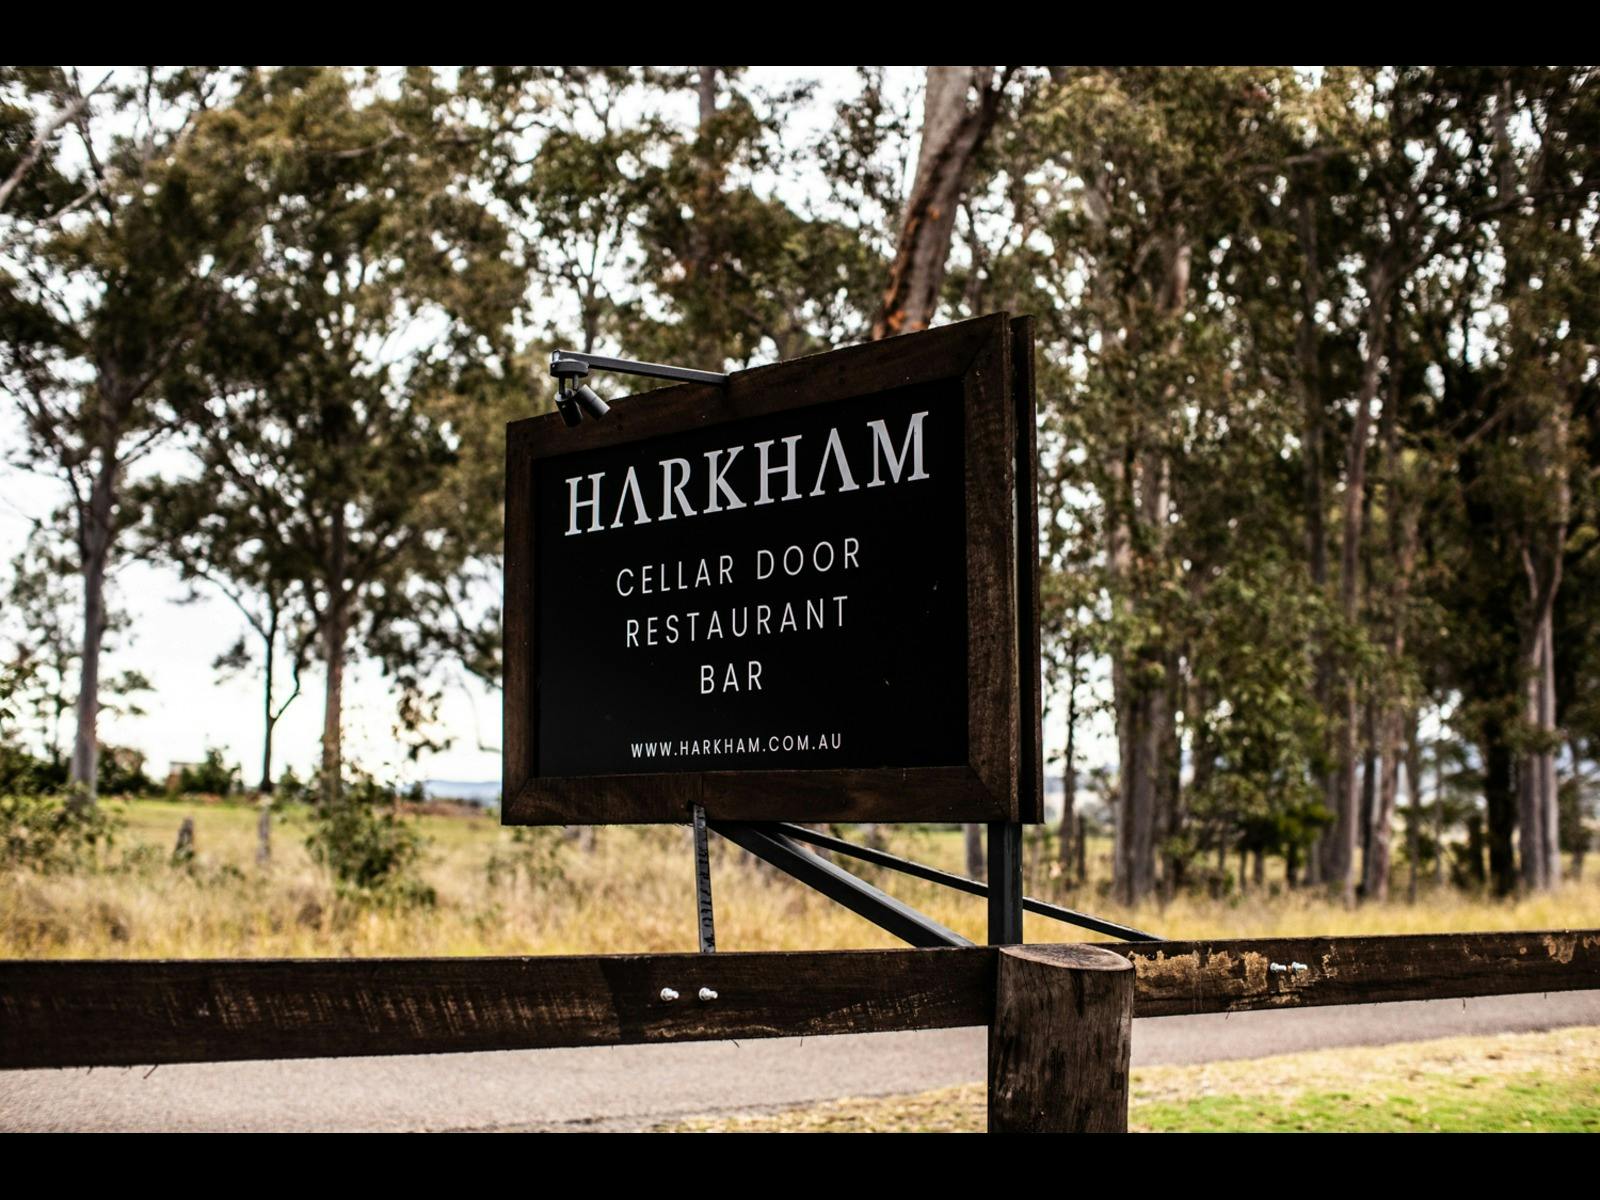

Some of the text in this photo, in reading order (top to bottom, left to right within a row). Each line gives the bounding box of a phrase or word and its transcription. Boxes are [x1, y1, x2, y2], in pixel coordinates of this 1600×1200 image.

[564, 411, 930, 537] HARKHAM
[616, 537, 860, 597] CELLAR DOOR
[626, 595, 848, 648] RESTAURANT
[700, 660, 763, 695] BAR
[630, 733, 842, 758] WWW.HARKHAM.COM.AU
